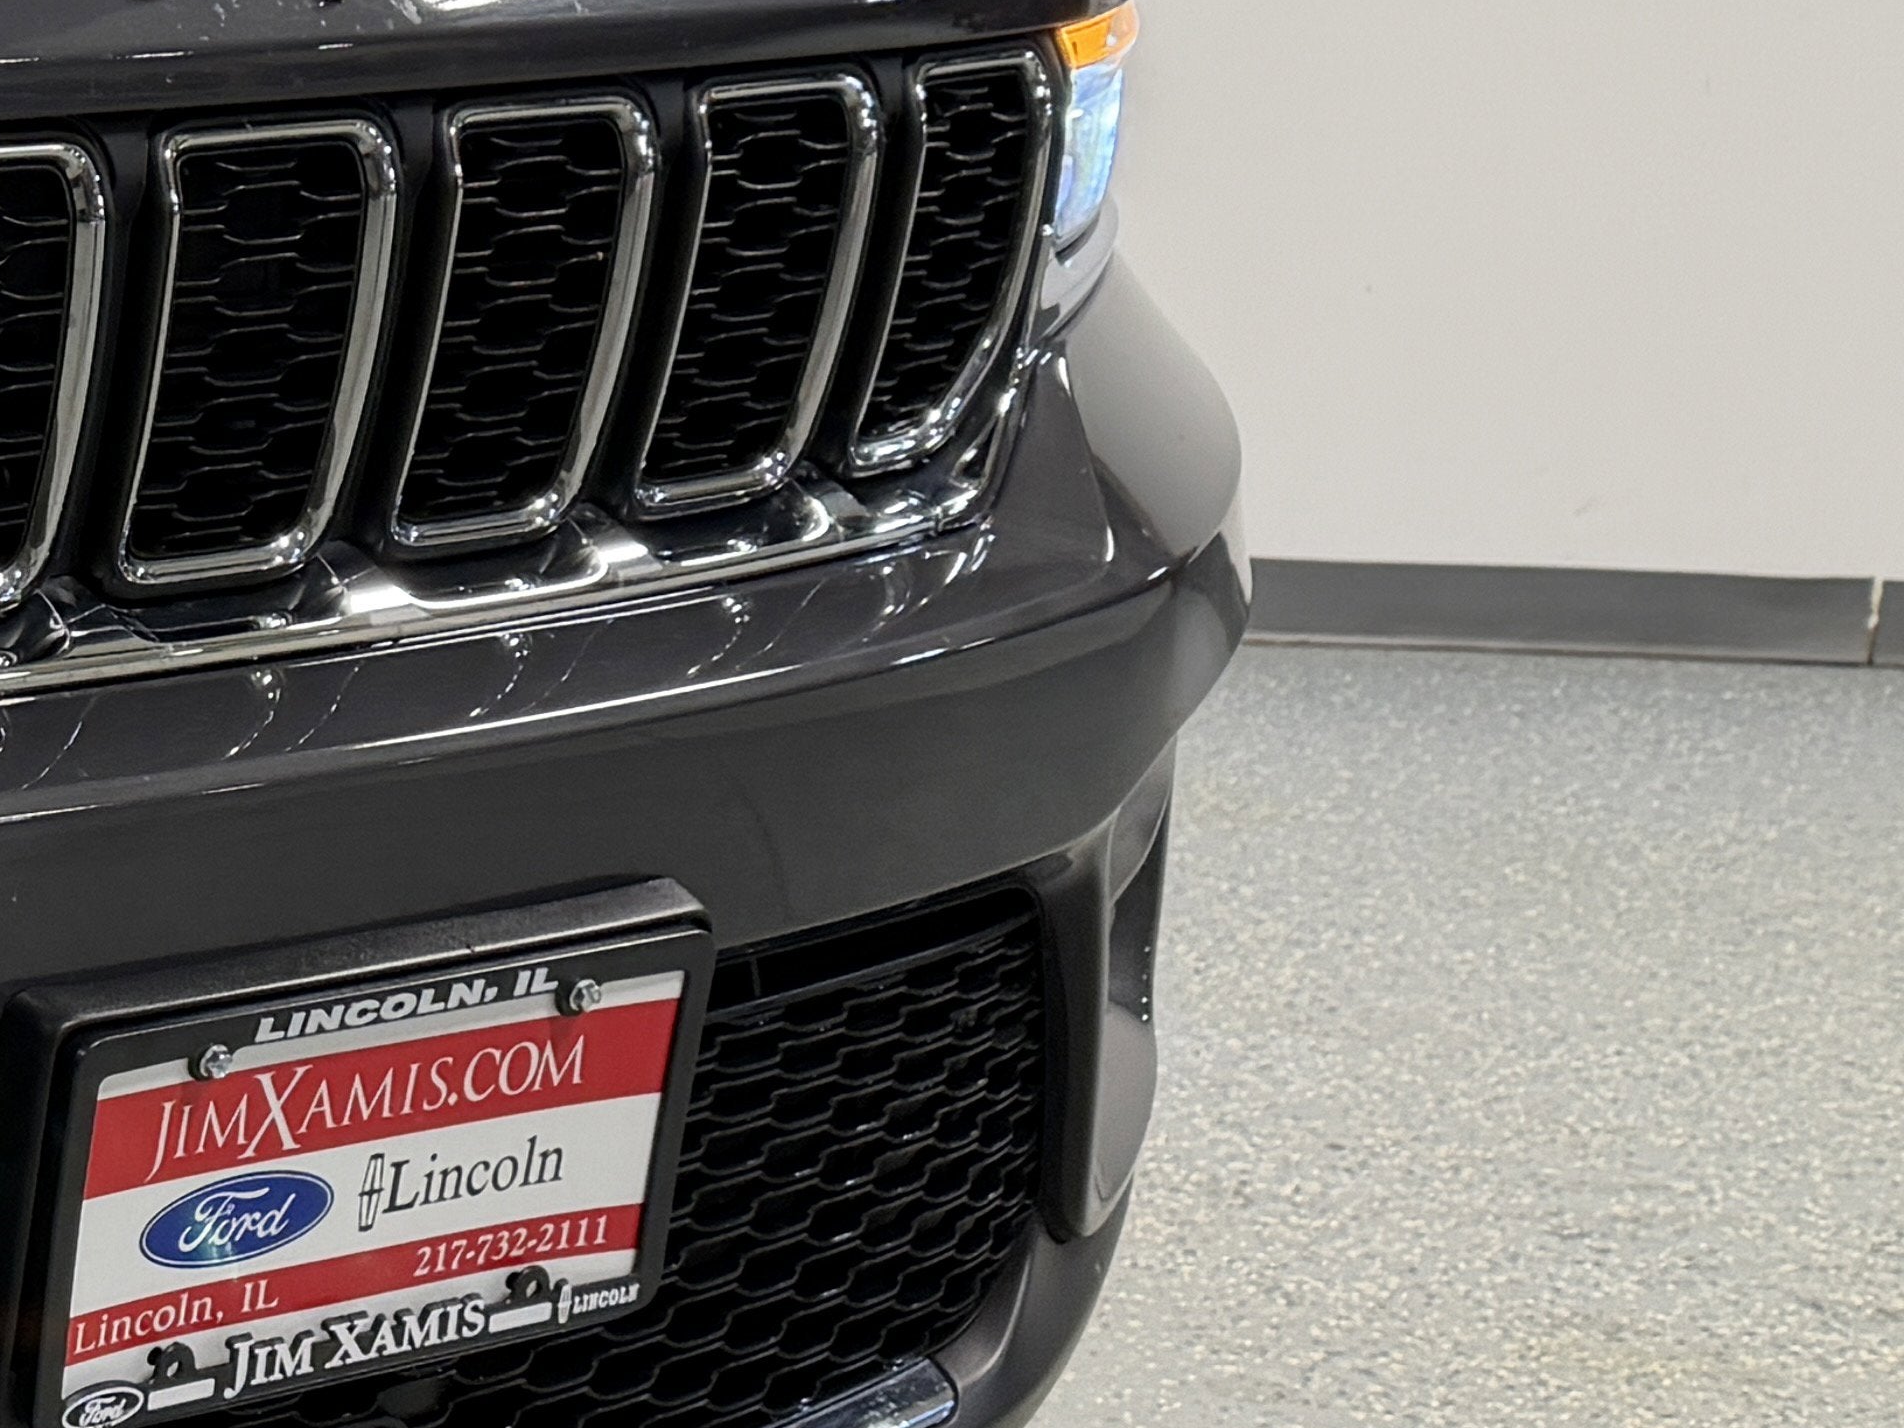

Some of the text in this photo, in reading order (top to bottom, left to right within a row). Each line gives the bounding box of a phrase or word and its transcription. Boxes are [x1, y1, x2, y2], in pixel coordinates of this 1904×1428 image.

[254, 966, 559, 1043] LINCOLN, IL
[144, 1034, 586, 1183] JIMXAMIS.COM
[381, 1134, 565, 1215] Lincoln
[176, 1186, 297, 1254] Ford
[412, 1215, 608, 1279] 217-732-2111
[73, 1279, 279, 1356] Lincoln, IL
[572, 1281, 641, 1315] LINCOLN
[223, 1298, 486, 1400] JIM XAMIS
